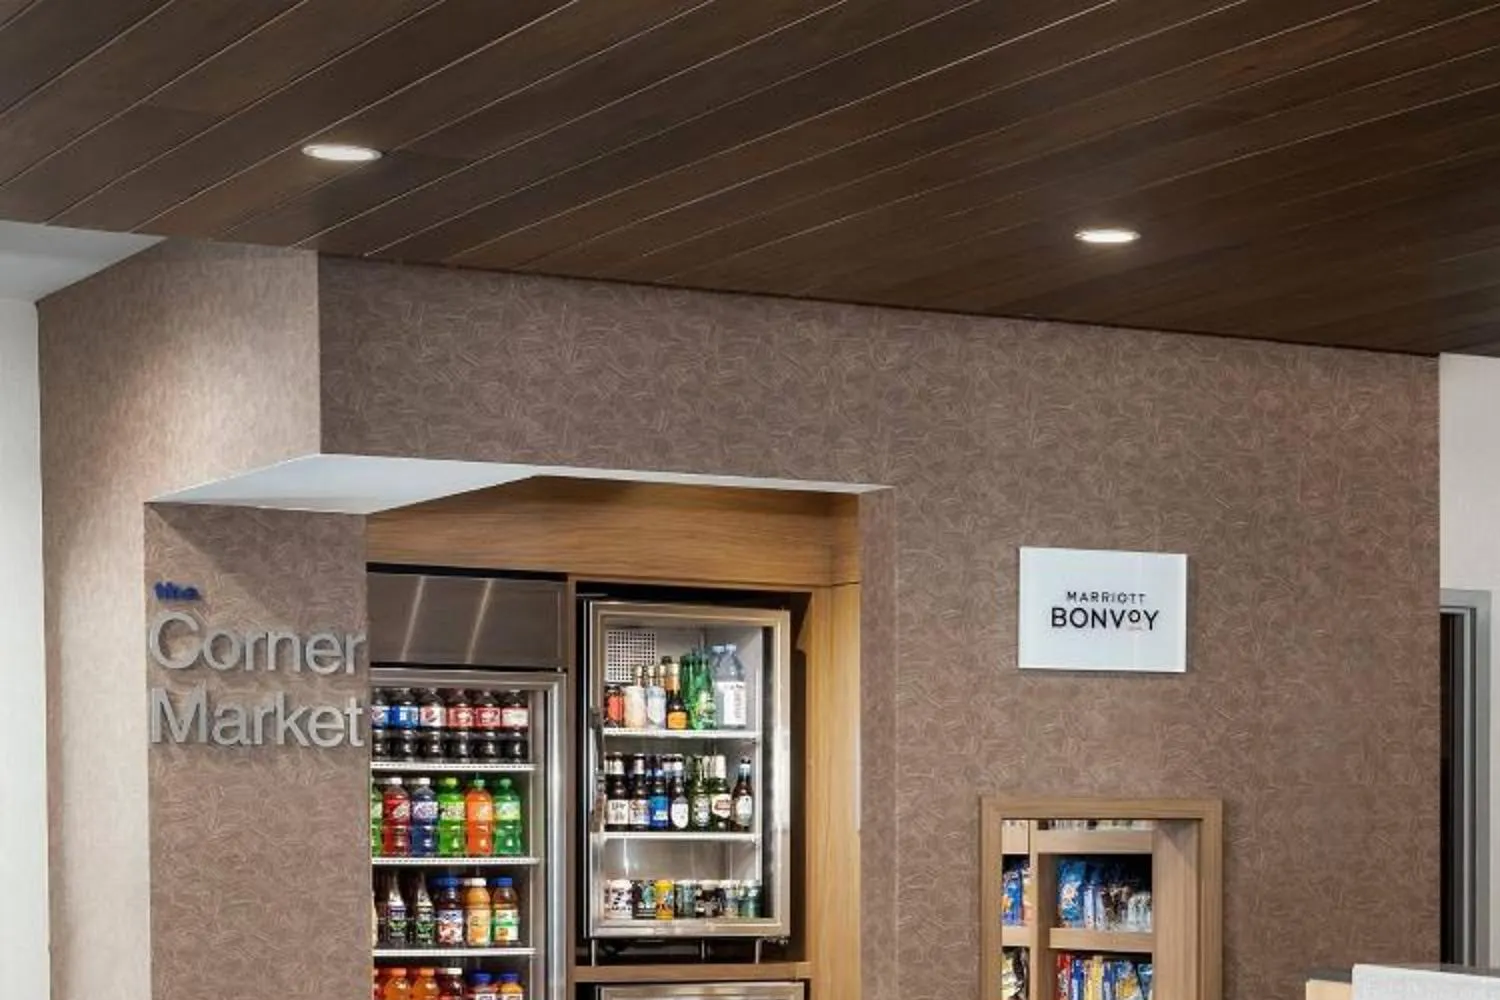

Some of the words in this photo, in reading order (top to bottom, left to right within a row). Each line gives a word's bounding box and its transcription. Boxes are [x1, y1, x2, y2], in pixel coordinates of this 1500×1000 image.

[1066, 591, 1147, 605] MARRIOTT
[150, 610, 368, 675] Corner
[151, 687, 365, 748] Market
